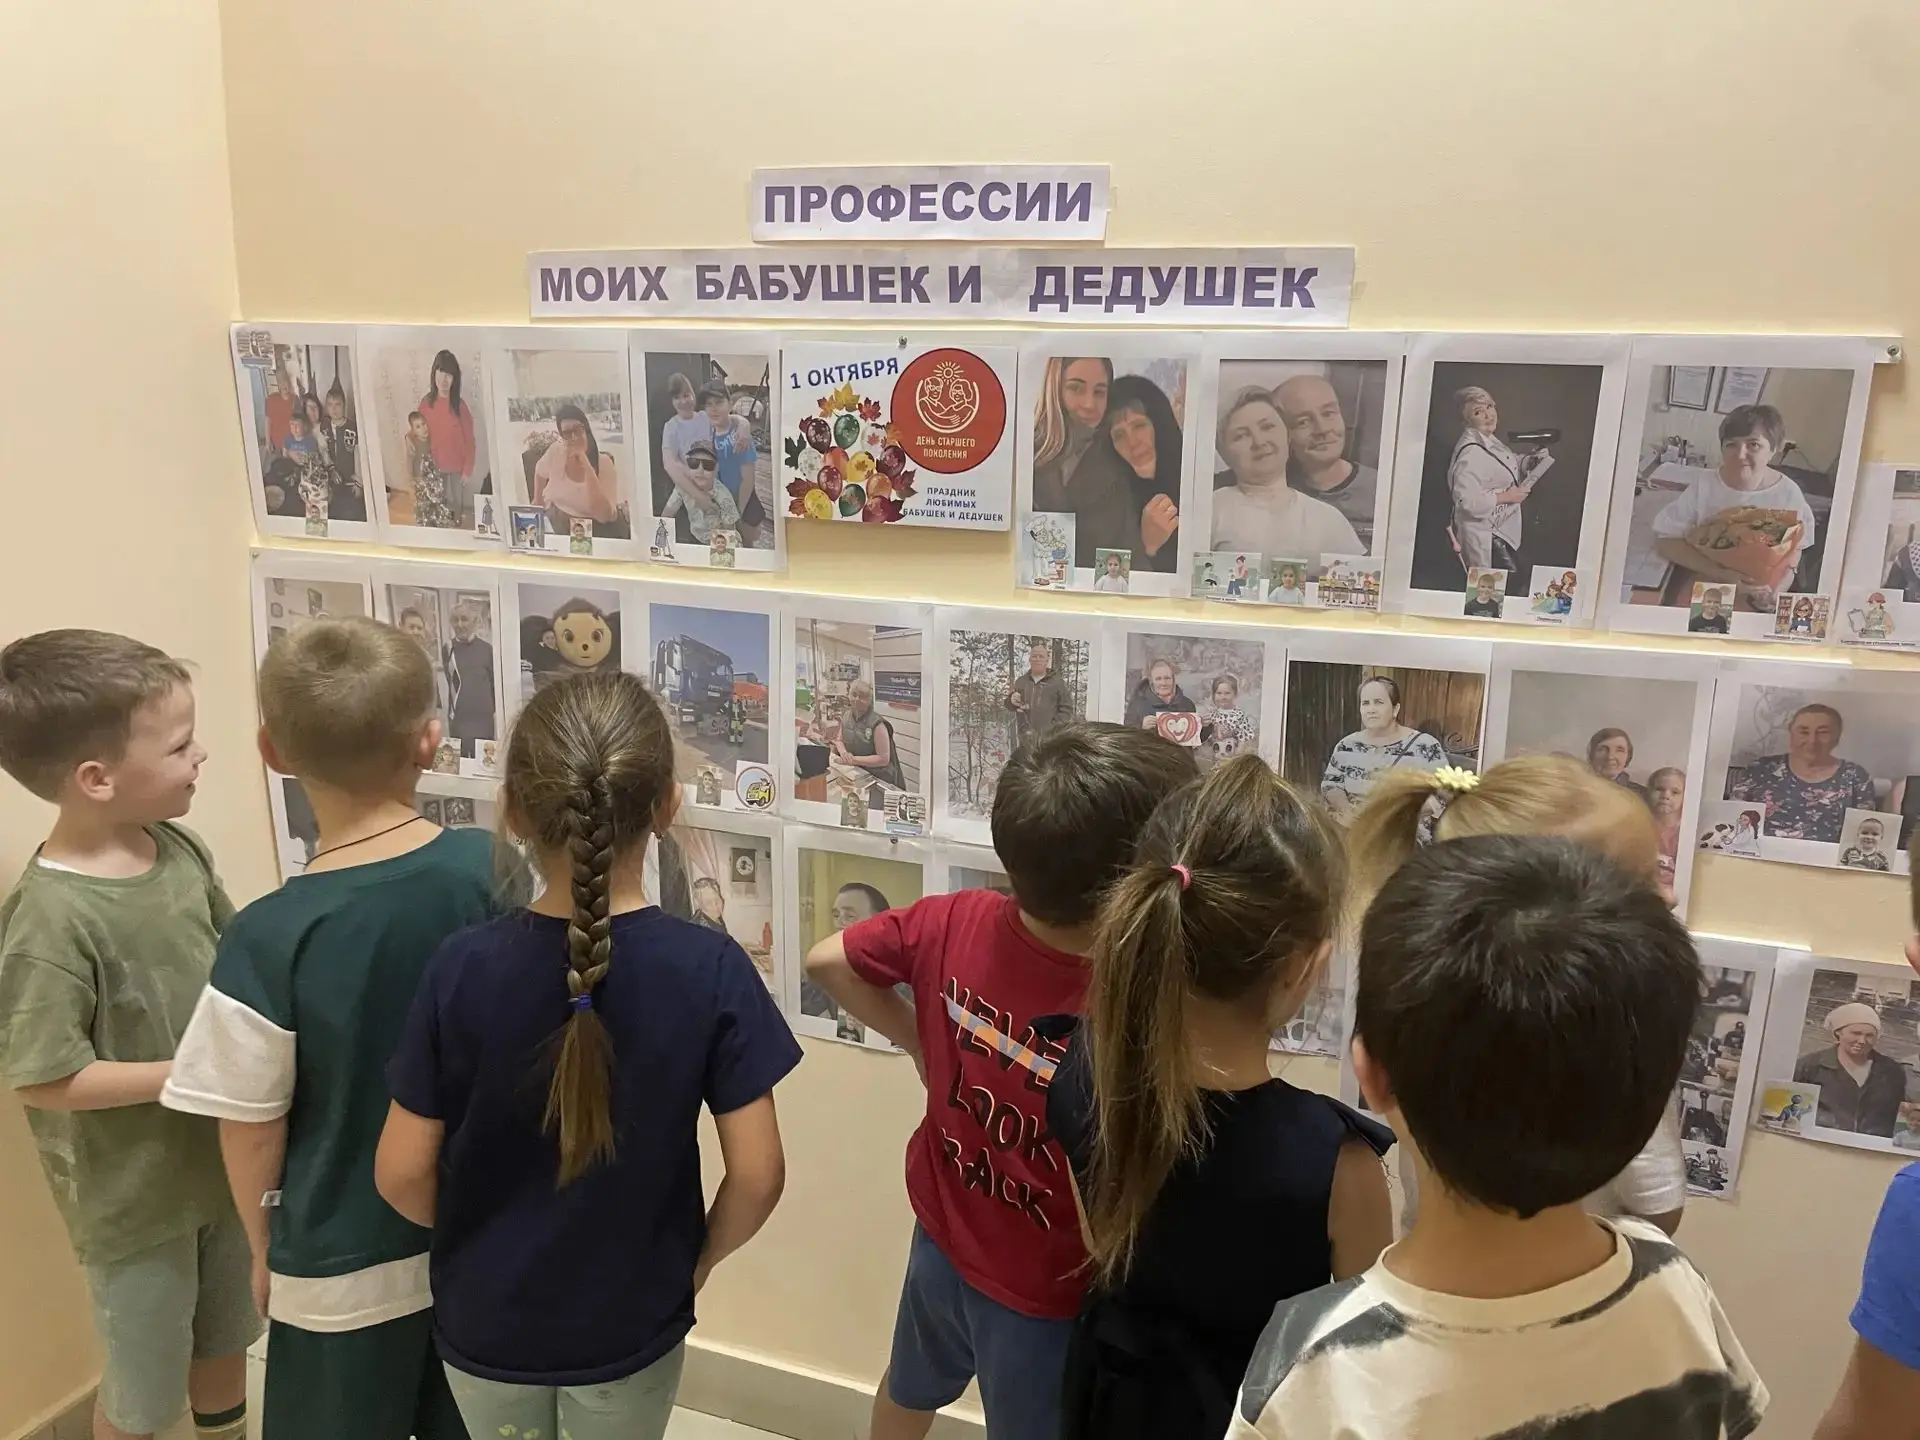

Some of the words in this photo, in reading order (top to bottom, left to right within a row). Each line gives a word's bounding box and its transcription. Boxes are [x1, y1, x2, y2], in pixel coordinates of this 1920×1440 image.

[765, 181, 1092, 223] ПРОФЕССИИ
[540, 266, 669, 302] МОИХ
[695, 264, 930, 304] БАБУШЕК
[948, 265, 982, 304] И
[1028, 265, 1319, 313] ДЕДУШЕК
[790, 372, 801, 390] 1
[807, 357, 899, 387] ОКТЯБРЯ
[916, 435, 936, 446] ДЕНЬ
[937, 436, 976, 447] СТАРШЕГО
[923, 448, 968, 459] ПОКОЛЕНИЯ
[925, 498, 977, 509] ЛЮБИМЫХ
[927, 487, 976, 497] ПРАЗДНИК
[903, 508, 946, 518] БАБУШЕК
[948, 511, 956, 519] И
[958, 511, 1004, 522] ДЕДУШЕК
[940, 976, 1067, 1093] NEVE
[949, 1066, 1059, 1173] LOOK
[941, 1127, 1051, 1232] BACK
